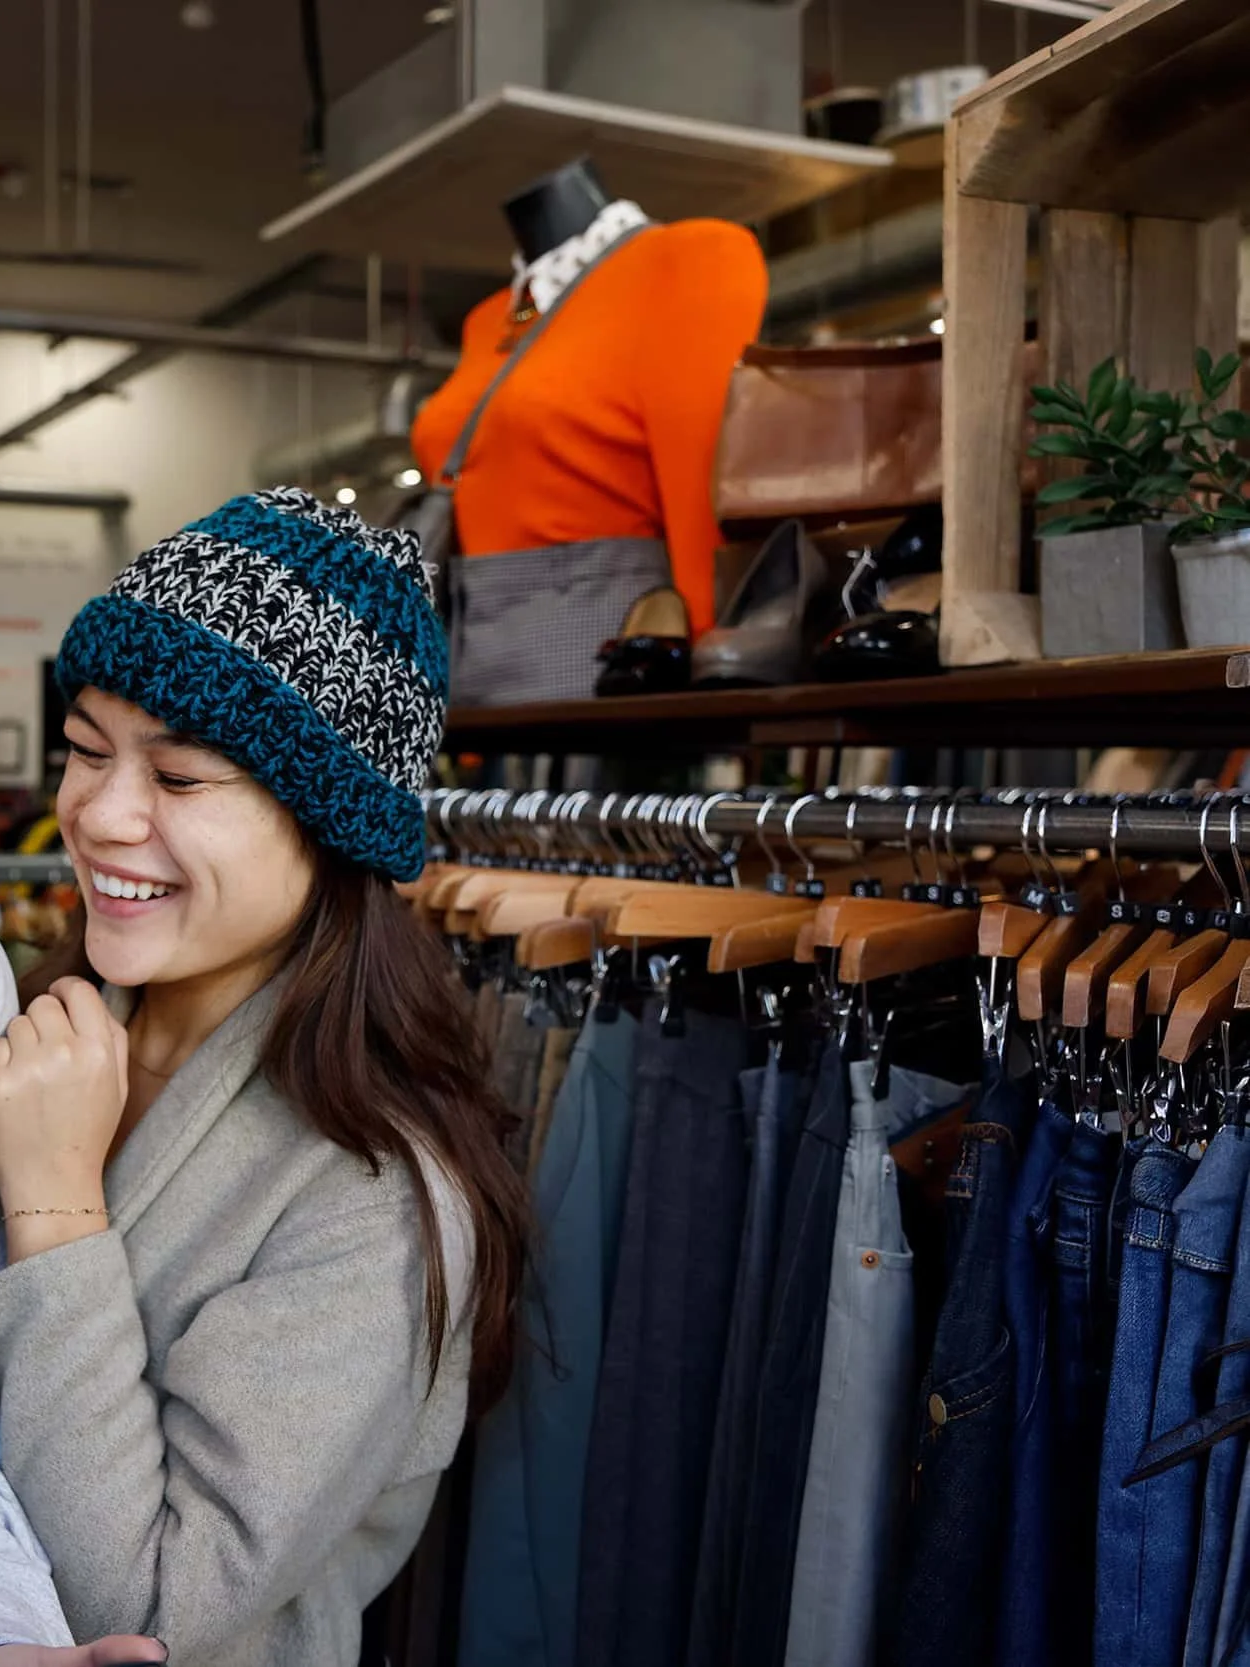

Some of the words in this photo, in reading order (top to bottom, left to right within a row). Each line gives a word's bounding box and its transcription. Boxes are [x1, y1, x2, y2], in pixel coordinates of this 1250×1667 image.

[928, 886, 939, 900] S
[953, 890, 964, 905] S
[1027, 890, 1045, 905] M
[1061, 899, 1074, 912] L
[1111, 904, 1123, 918] S
